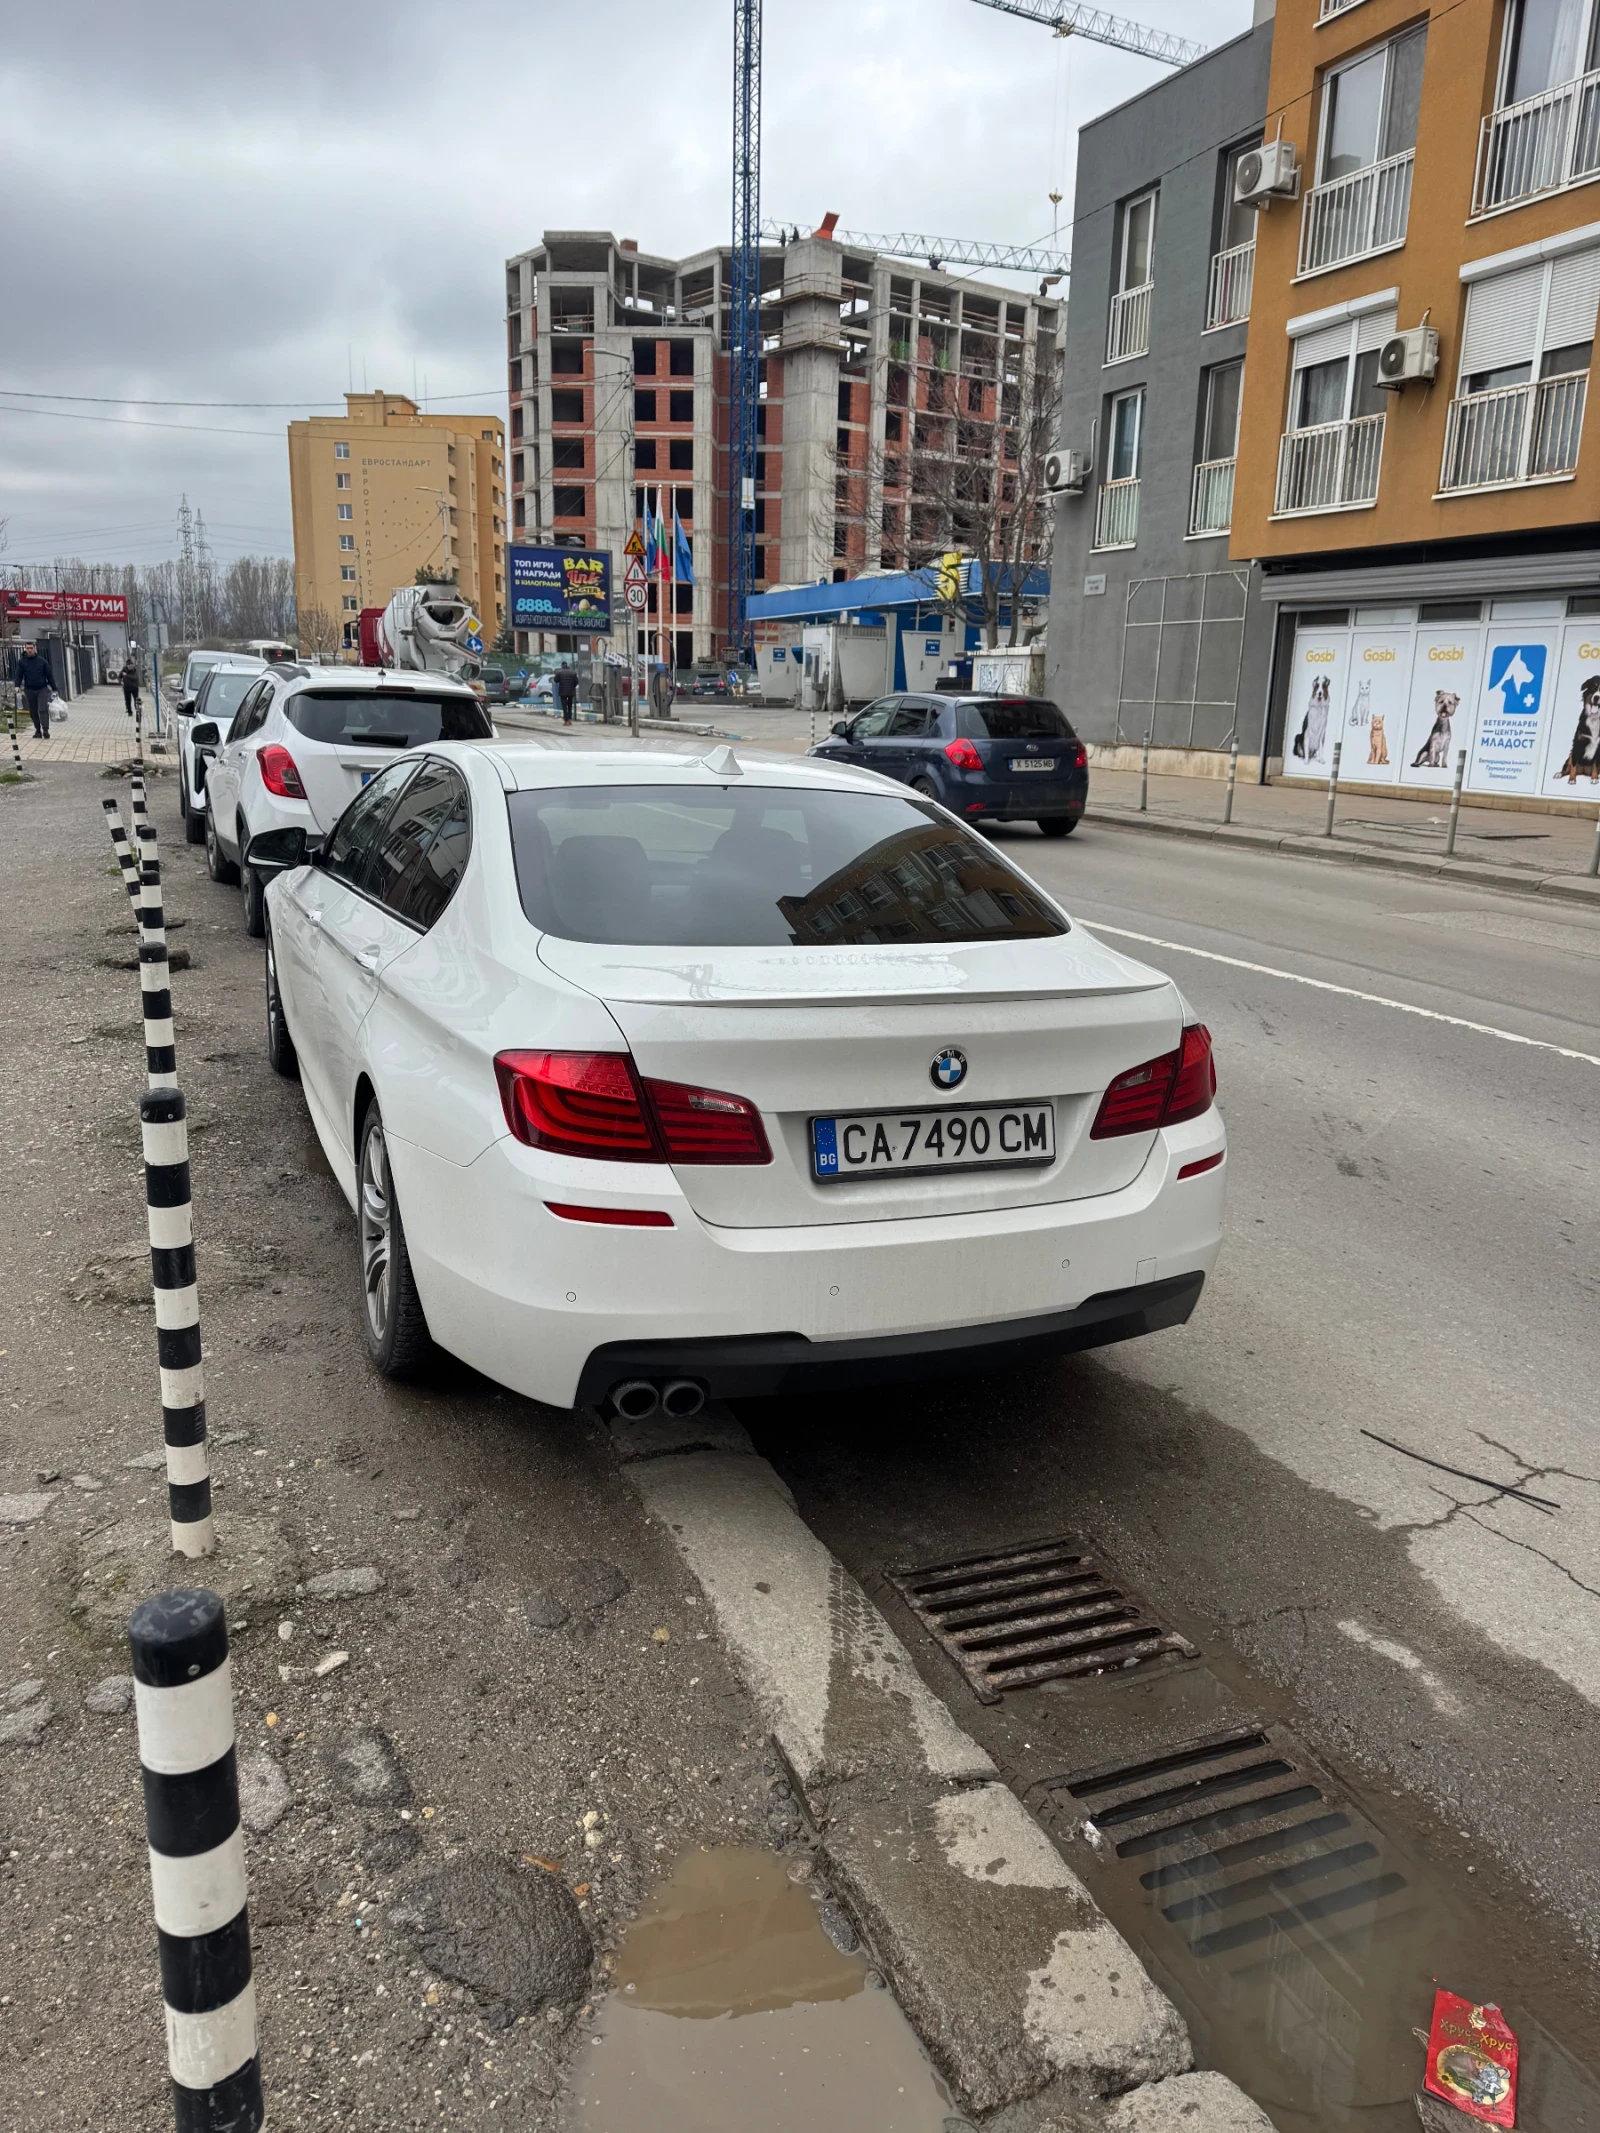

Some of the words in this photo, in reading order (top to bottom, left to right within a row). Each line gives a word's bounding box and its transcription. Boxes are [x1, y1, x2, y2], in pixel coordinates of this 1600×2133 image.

[362, 458, 431, 467] ЕВРОСТАНДАРТ
[514, 559, 531, 568] ТОП
[533, 560, 554, 569] ИГРИ
[562, 557, 604, 574] BAR
[514, 569, 521, 577] И
[523, 570, 561, 579] НАГРАДИ
[521, 579, 561, 587] КИЛОГРАМИ
[630, 589, 643, 603] 30
[45, 601, 81, 610] СЕРВИЗ
[82, 598, 124, 612] ГУМИ
[1305, 649, 1335, 662] Gosbi
[1363, 648, 1396, 662] Gosbi
[1428, 647, 1464, 661] Gosbi
[1483, 719, 1538, 727] ВЕТЕРИНАРЕН
[1481, 737, 1535, 749] МЛАДОСТ
[935, 1050, 966, 1064] BMW
[843, 1123, 892, 1164] CA
[900, 1116, 990, 1160] 7490
[999, 1112, 1047, 1152] CM
[820, 1153, 836, 1166] BG
